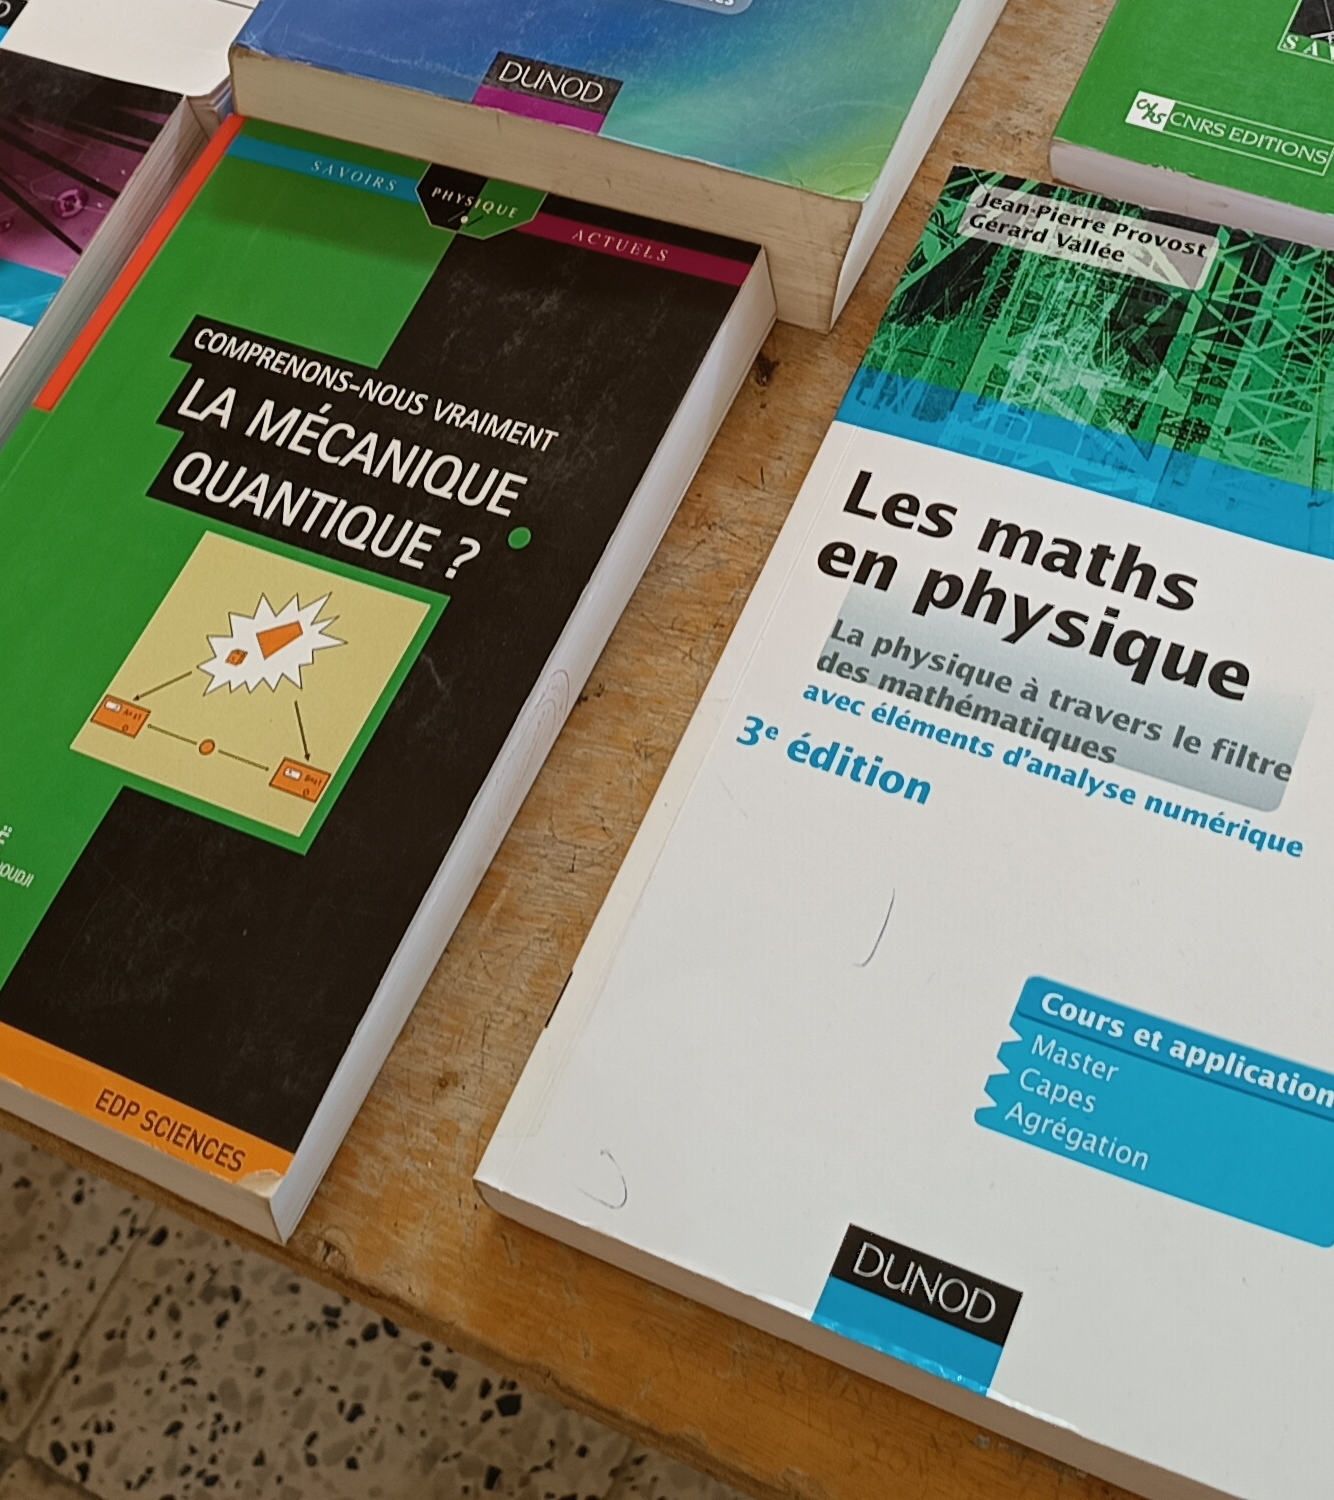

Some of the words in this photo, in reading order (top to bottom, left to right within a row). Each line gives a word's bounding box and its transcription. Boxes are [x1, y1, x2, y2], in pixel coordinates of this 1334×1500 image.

[176, 376, 238, 428] LA
[243, 399, 529, 519] MÉCANIQUE
[193, 327, 429, 418] COMPRENONS-NOUS
[432, 397, 561, 454] VRAIMENT
[171, 450, 445, 571] QUANTIQUE
[444, 534, 483, 581] ?
[842, 469, 961, 539] Les
[976, 514, 1201, 614] maths
[816, 536, 901, 592] en
[911, 561, 1253, 703] physique
[851, 1241, 997, 1325] DUNOD
